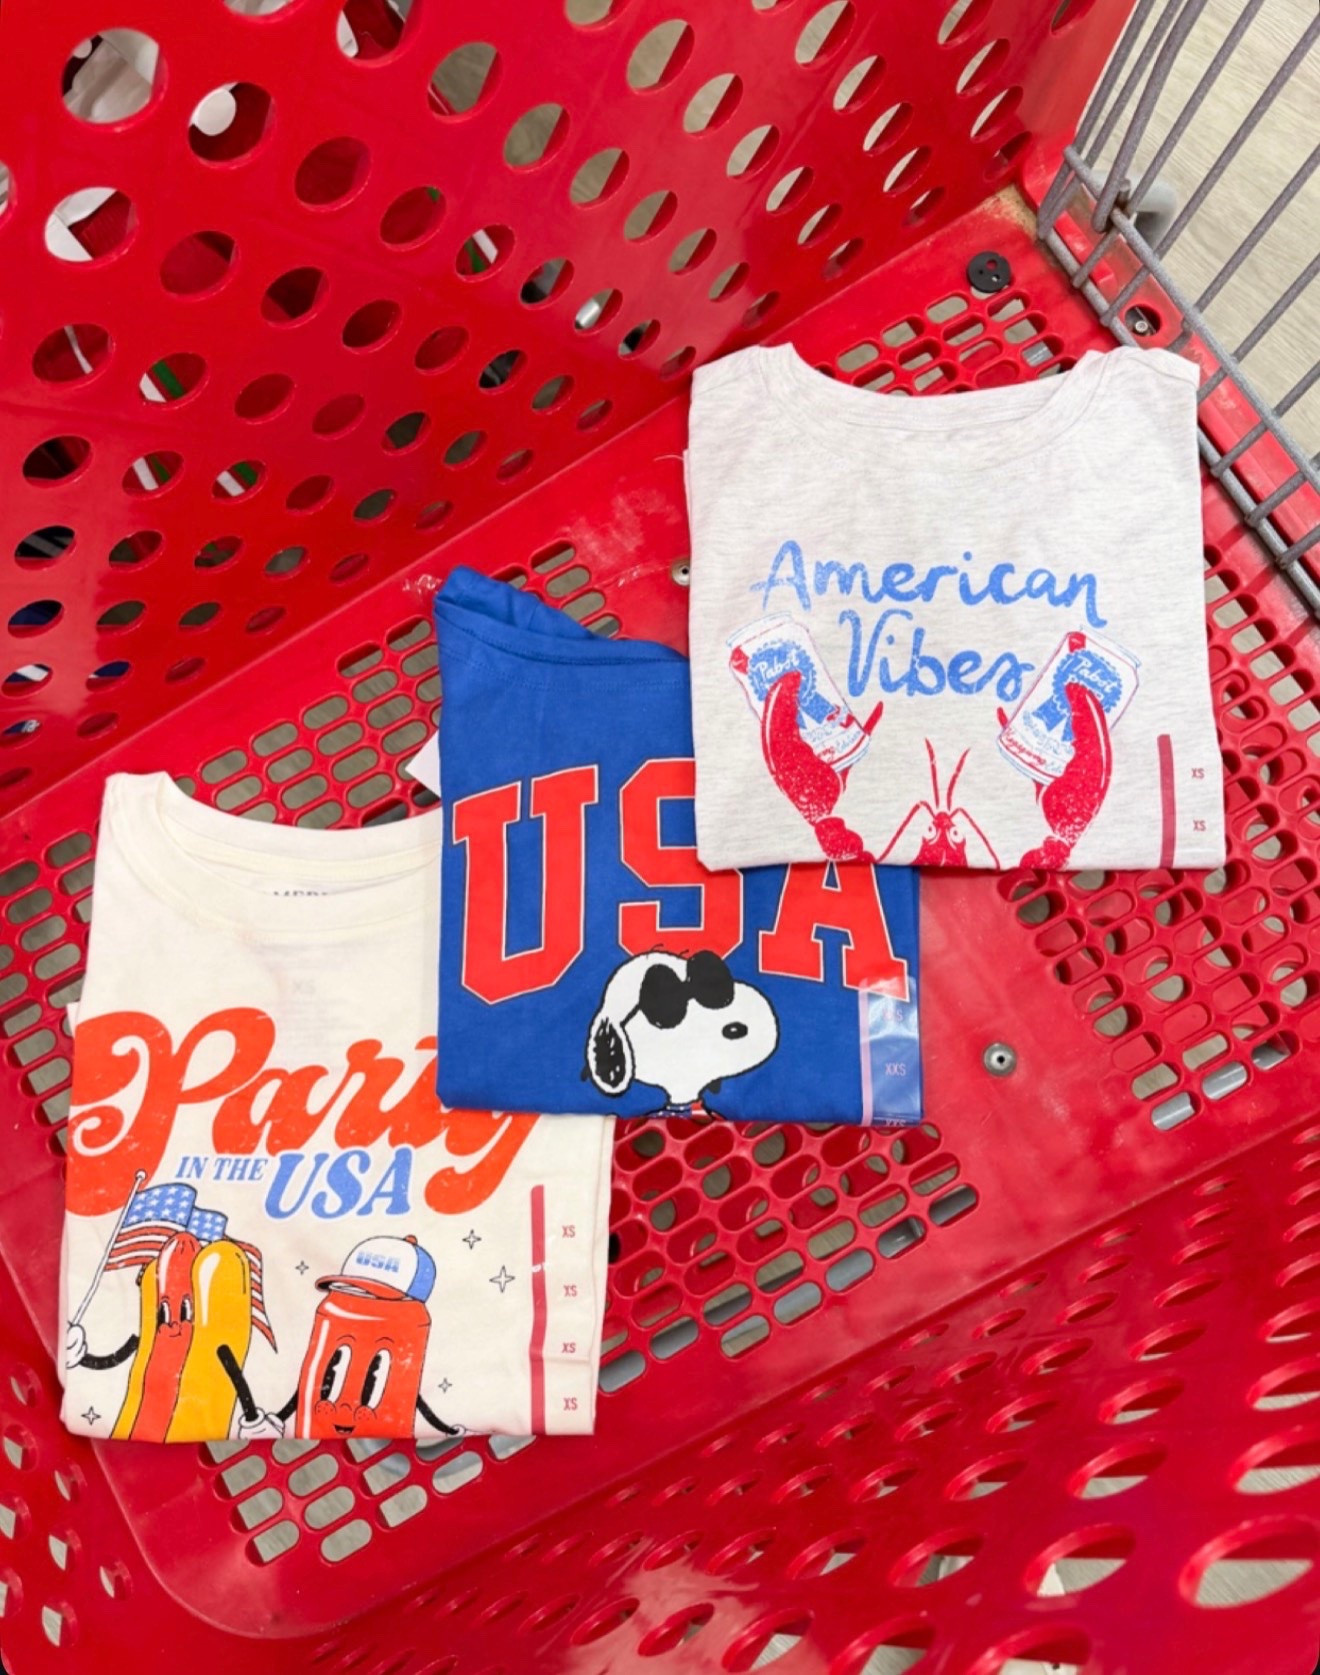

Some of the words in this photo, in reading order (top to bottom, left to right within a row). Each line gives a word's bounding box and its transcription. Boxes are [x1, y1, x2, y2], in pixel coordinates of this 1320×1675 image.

[750, 540, 1107, 627] American
[840, 609, 1035, 701] Vibes
[752, 648, 800, 682] Pabst
[1074, 655, 1117, 693] Pabst
[1191, 768, 1205, 779] XS
[1193, 820, 1206, 831] XS
[452, 757, 910, 1002] USA
[885, 1063, 906, 1076] XXS
[175, 1156, 208, 1179] IN
[212, 1157, 268, 1181] THE
[265, 1147, 413, 1219] USA
[562, 1225, 575, 1238] XS
[356, 1251, 400, 1273] USA
[564, 1285, 577, 1297] XS
[562, 1343, 576, 1353] XS
[563, 1397, 578, 1411] XS
